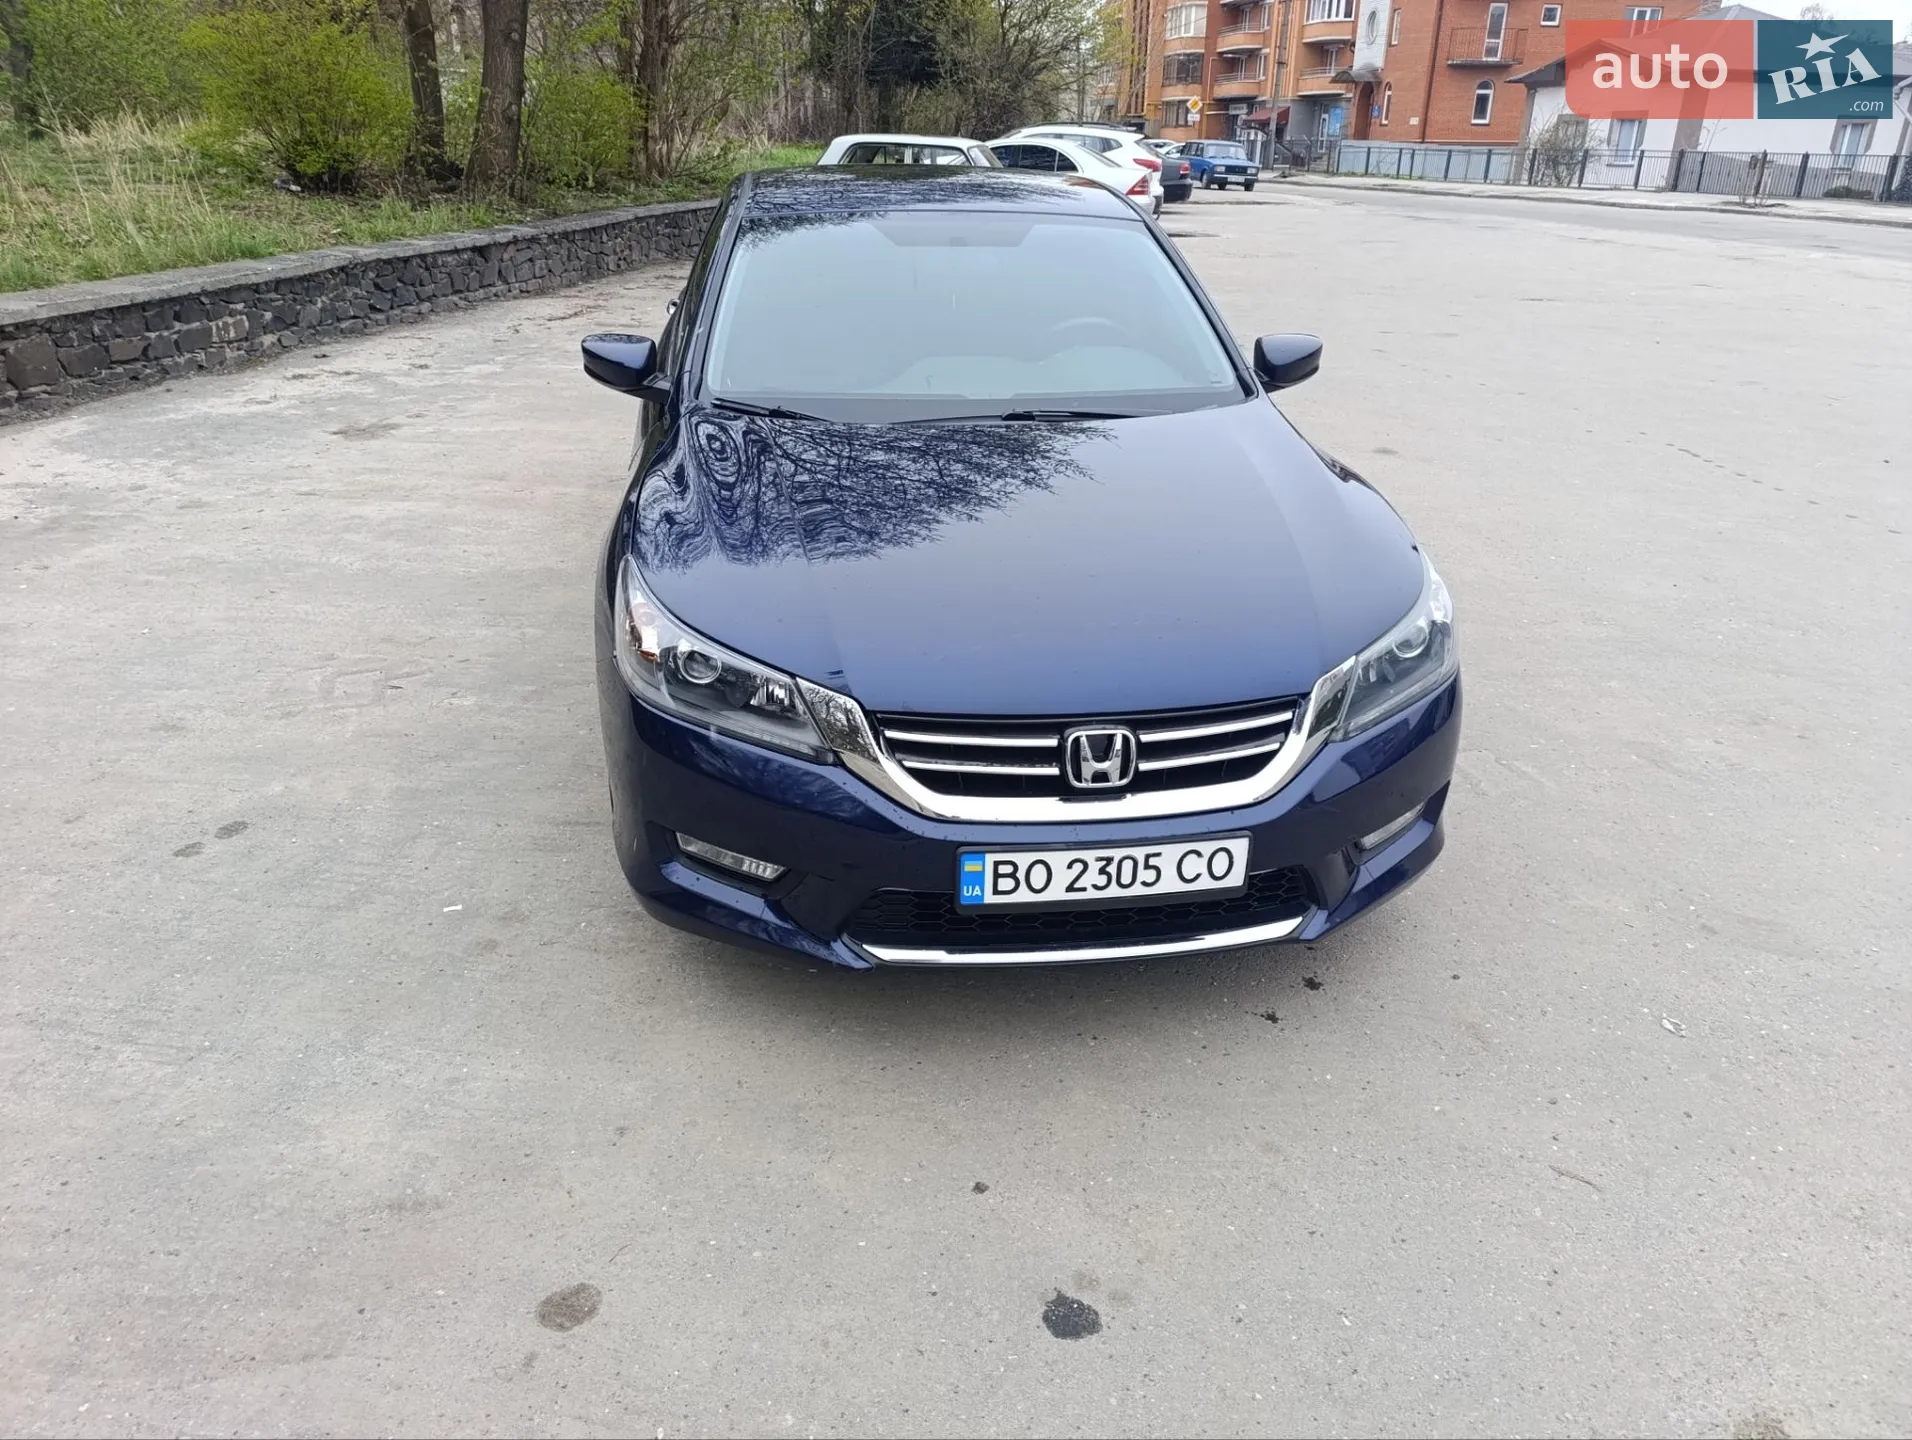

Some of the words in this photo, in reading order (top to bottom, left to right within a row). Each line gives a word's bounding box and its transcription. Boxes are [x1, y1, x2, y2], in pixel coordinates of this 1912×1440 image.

[992, 858, 1053, 896] BO
[1065, 852, 1163, 893] 2305
[1176, 846, 1235, 884] CO
[963, 885, 982, 897] UA
